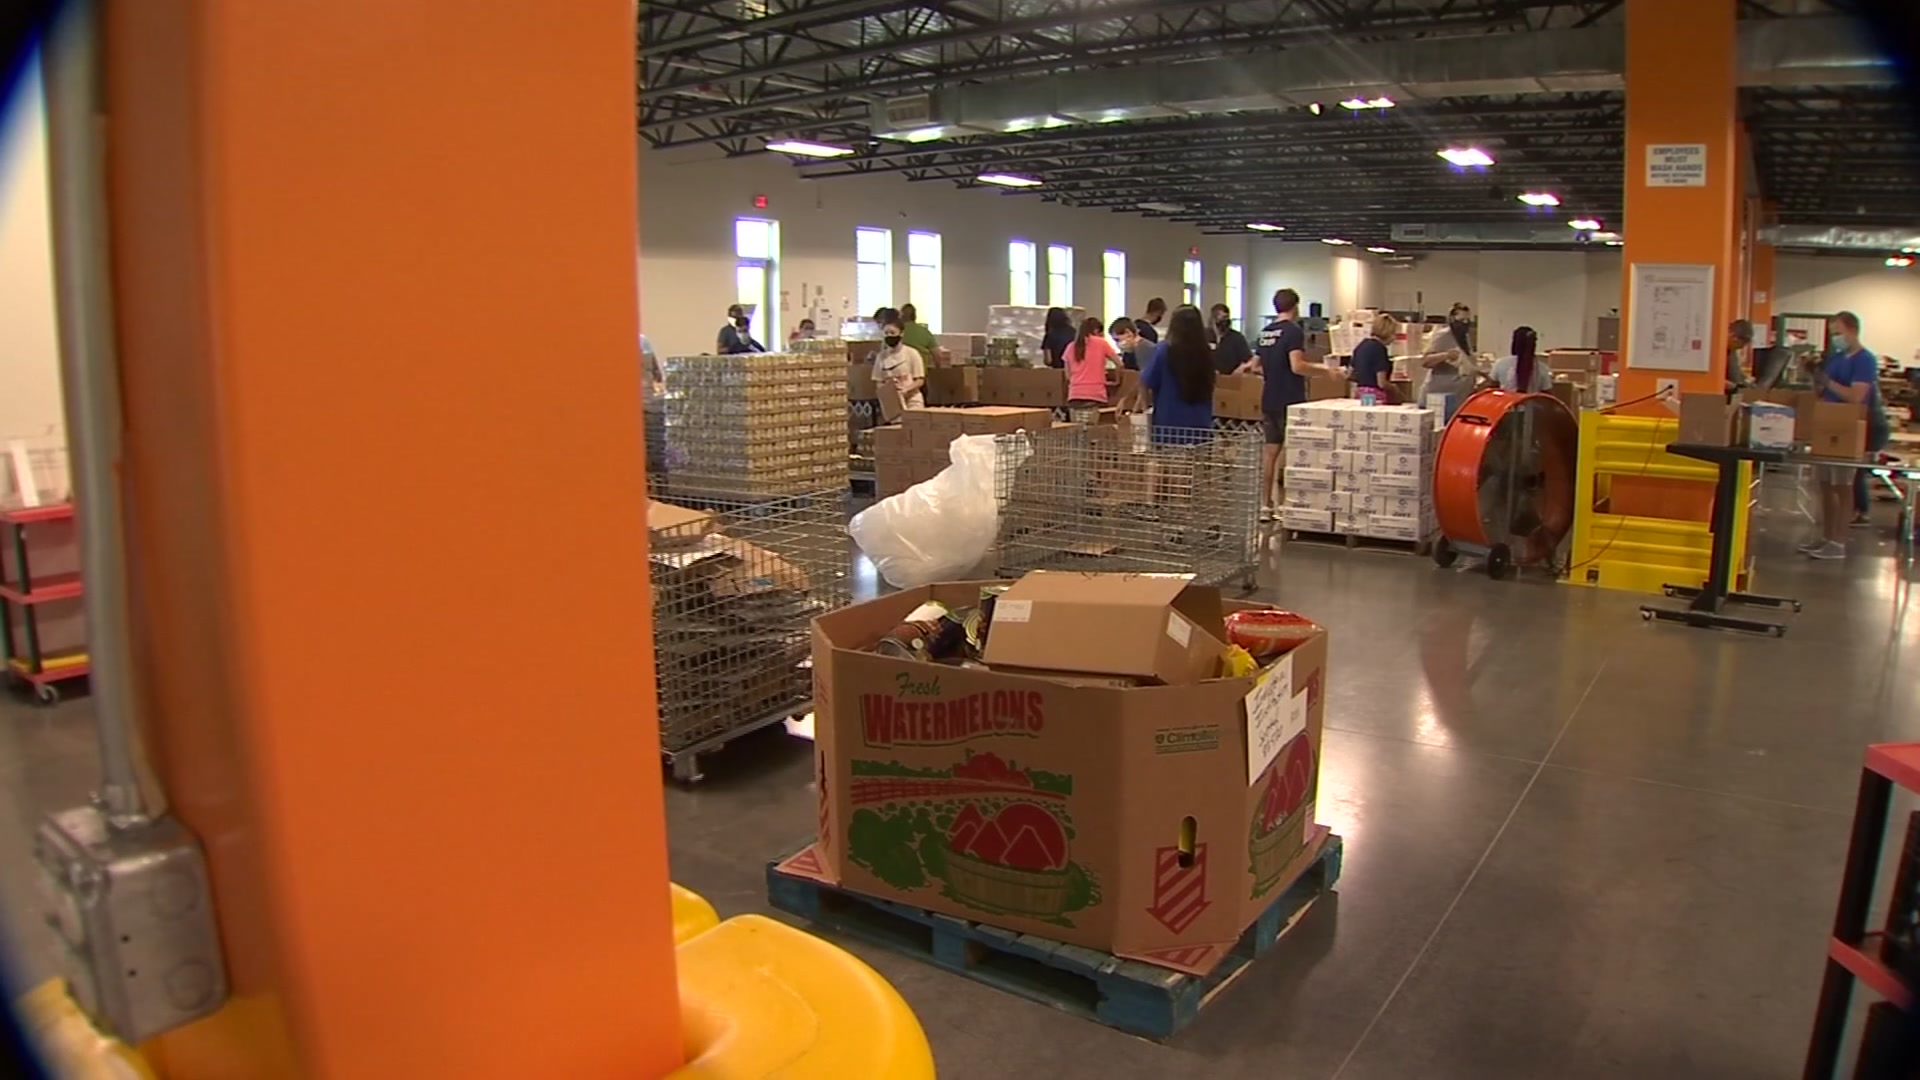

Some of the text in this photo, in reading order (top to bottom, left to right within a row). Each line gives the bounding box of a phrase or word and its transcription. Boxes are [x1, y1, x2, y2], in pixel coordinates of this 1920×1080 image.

[1653, 147, 1700, 155] EMPLOYEES
[1664, 155, 1688, 163] MUST
[896, 672, 941, 697] Fresh
[863, 689, 1043, 744] WATERMELONS
